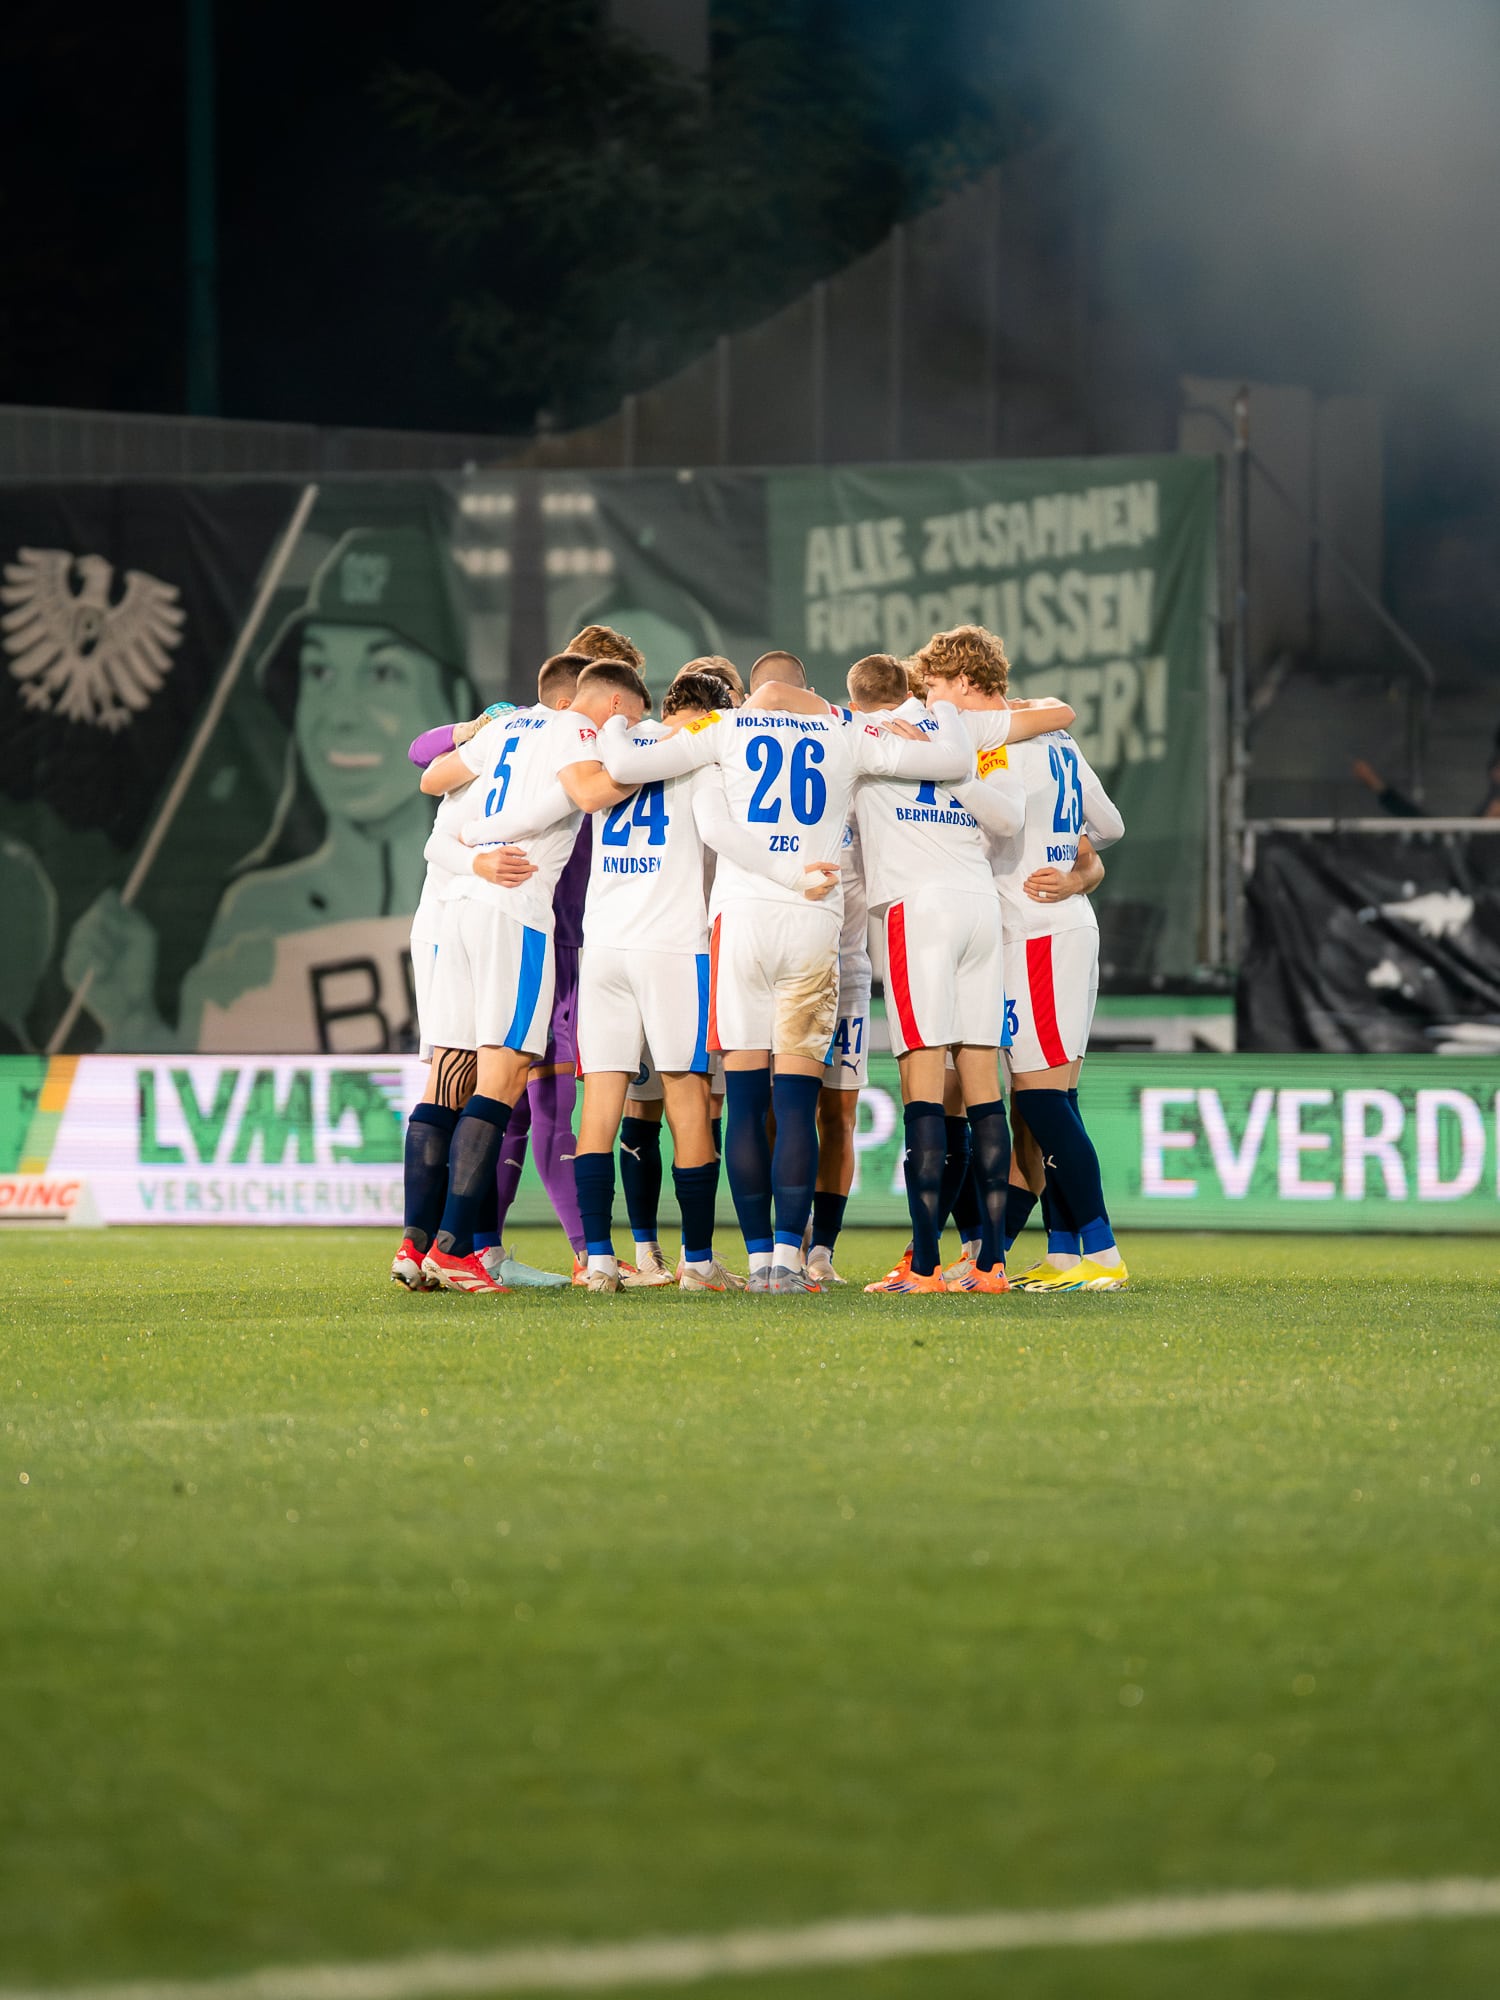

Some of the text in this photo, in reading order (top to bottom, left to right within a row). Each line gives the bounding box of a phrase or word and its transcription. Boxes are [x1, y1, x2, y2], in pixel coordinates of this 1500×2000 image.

[805, 480, 1160, 597] ALLE ZUSAMMEN
[485, 736, 520, 818] 5
[745, 734, 827, 826] 26
[979, 758, 1006, 775] LOTTO
[1048, 744, 1083, 835] 23
[601, 781, 670, 847] 24
[768, 835, 800, 853] ZEC
[895, 807, 978, 829] BERNHARDSSO
[836, 1017, 864, 1056] 47
[137, 1069, 316, 1165] LVM
[1140, 1087, 1500, 1201] EVERD
